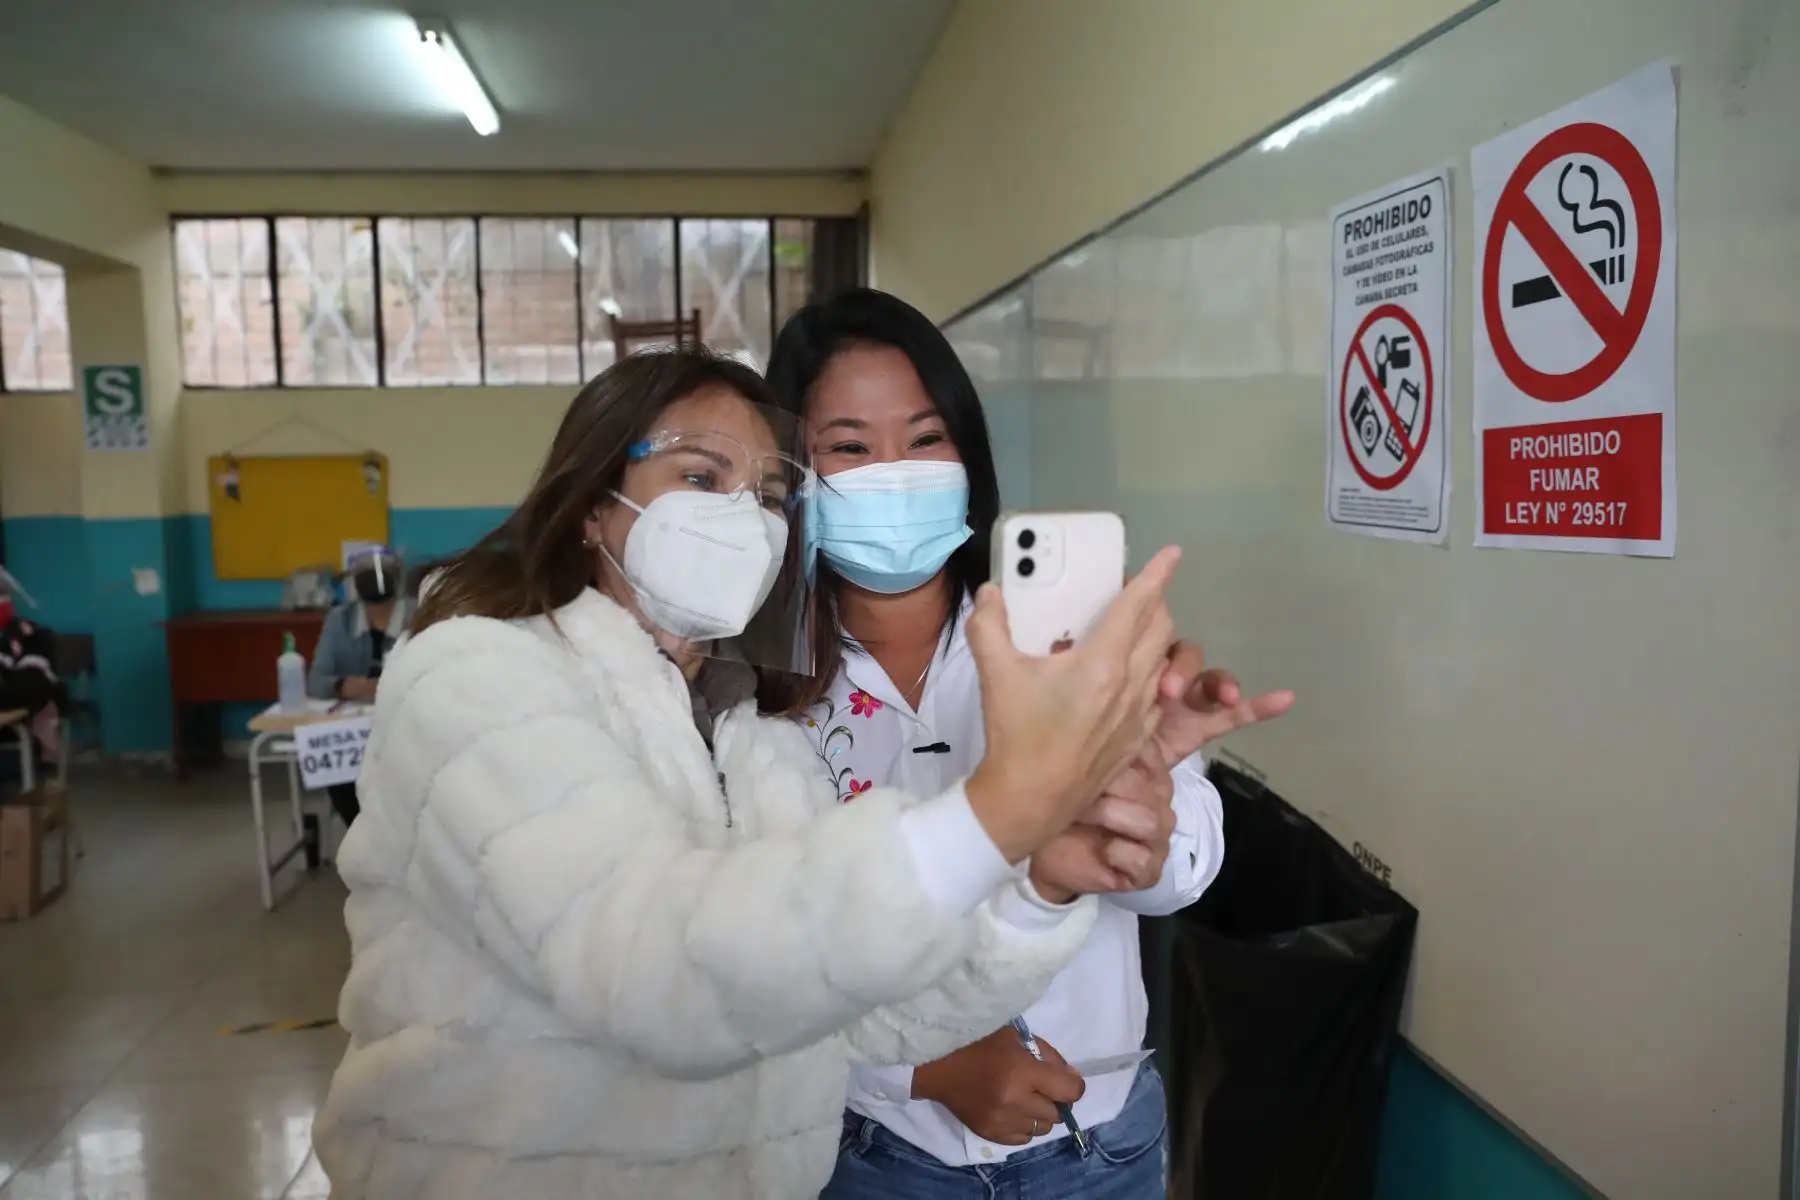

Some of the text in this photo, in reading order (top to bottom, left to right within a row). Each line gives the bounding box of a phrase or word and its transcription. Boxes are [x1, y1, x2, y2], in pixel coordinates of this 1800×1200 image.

[1344, 194, 1432, 244] PROHIBIDO
[1371, 239, 1380, 252] DE
[1362, 276, 1371, 288] DE
[1395, 267, 1406, 280] EN
[1407, 264, 1418, 276] LA
[93, 370, 135, 414] S
[1510, 430, 1621, 460] PROHIBIDO
[1530, 467, 1600, 492] FUMAR
[1505, 502, 1541, 525] LEY
[1572, 502, 1627, 526] 29517
[309, 730, 357, 749] MESA
[1353, 840, 1392, 886] ONPE
